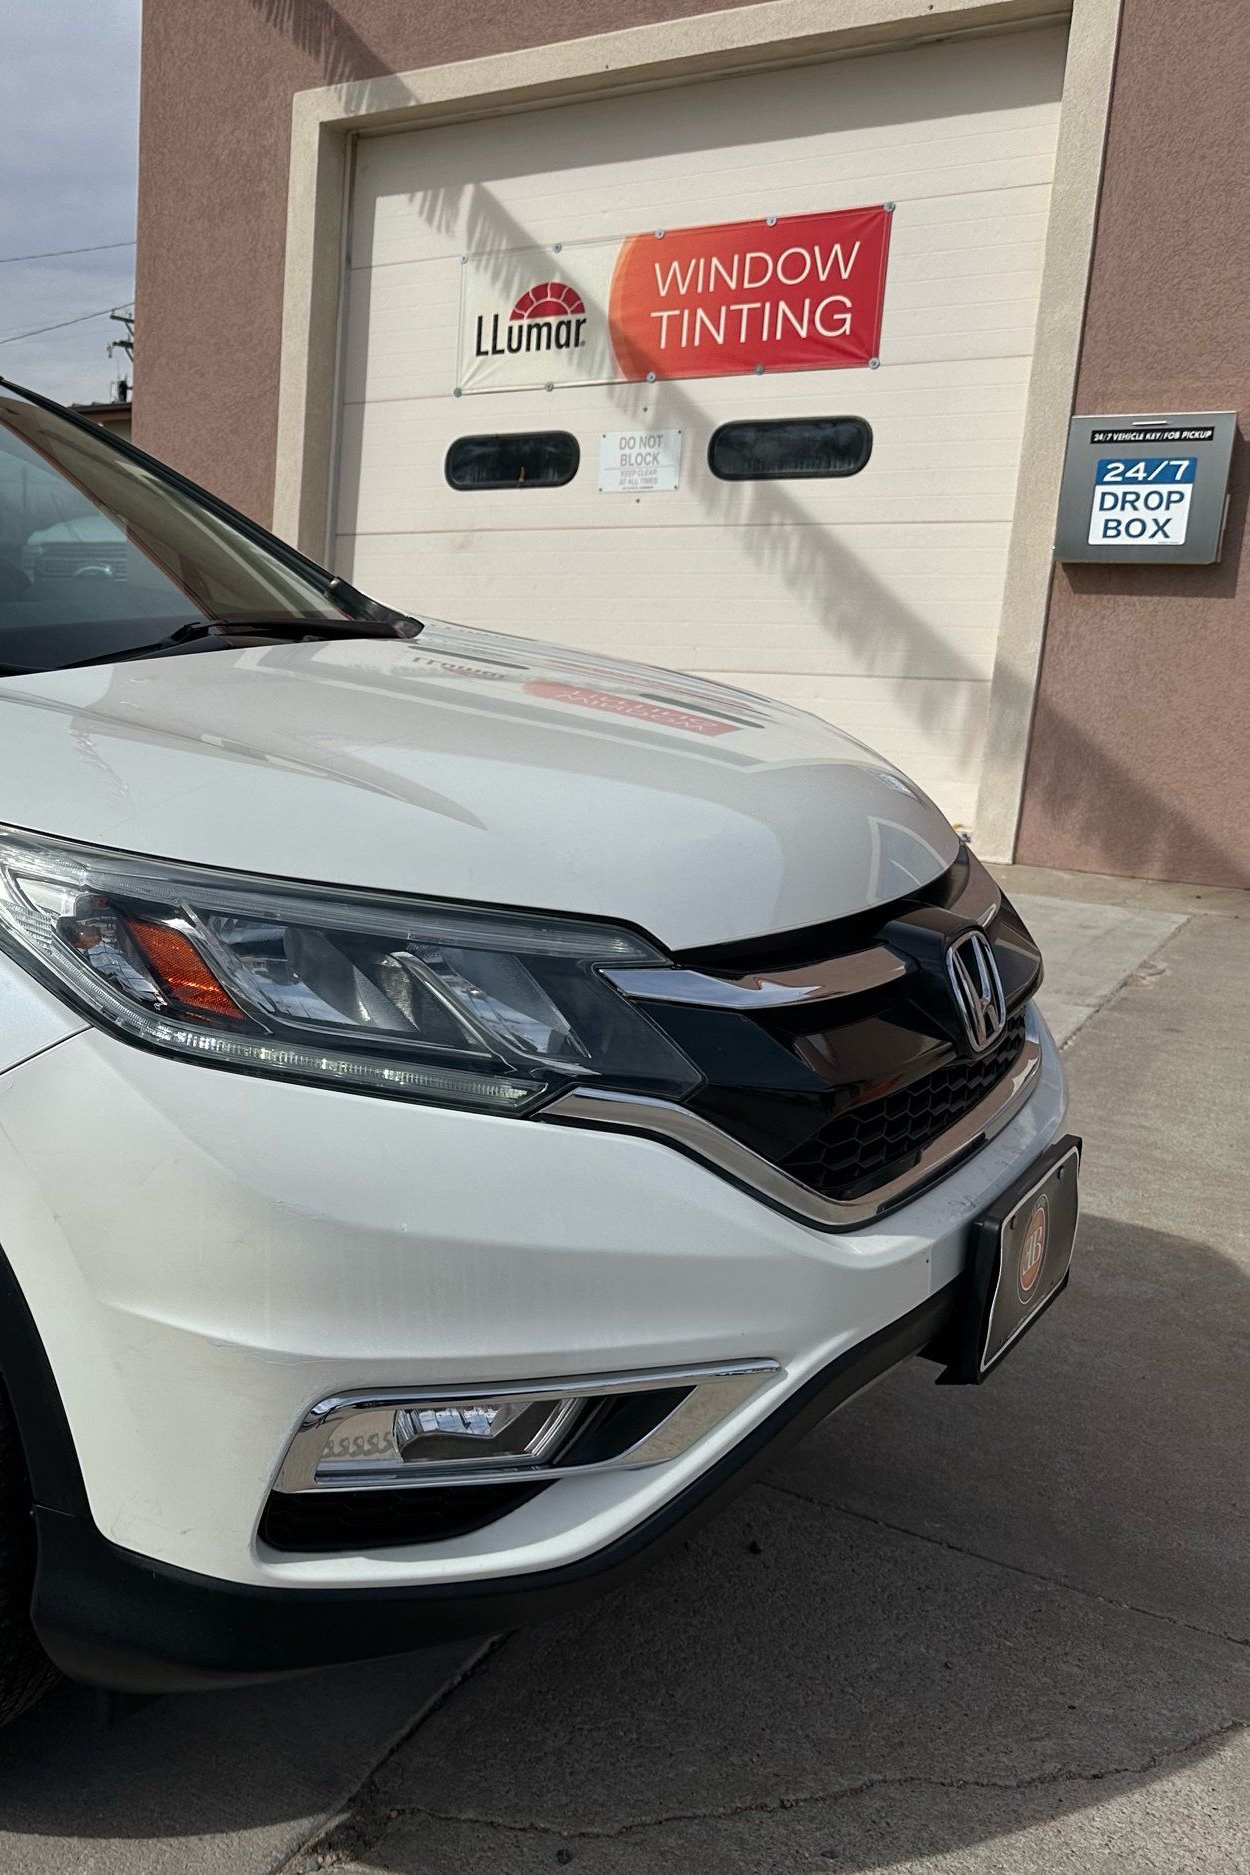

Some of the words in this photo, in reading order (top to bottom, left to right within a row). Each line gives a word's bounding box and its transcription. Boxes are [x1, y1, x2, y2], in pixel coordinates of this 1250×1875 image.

[654, 241, 860, 297] WINDOW
[651, 295, 853, 349] TINTING
[475, 314, 587, 357] LLumar
[619, 436, 636, 450] DO
[639, 434, 664, 449] NOT
[1093, 433, 1112, 441] 24/7
[1113, 432, 1144, 441] VEHICLE
[1181, 430, 1213, 439] PICKUP
[620, 452, 660, 467] BLOCK
[1102, 460, 1190, 482] 24/7
[1099, 490, 1185, 512] DROP
[1102, 517, 1173, 539] BOX
